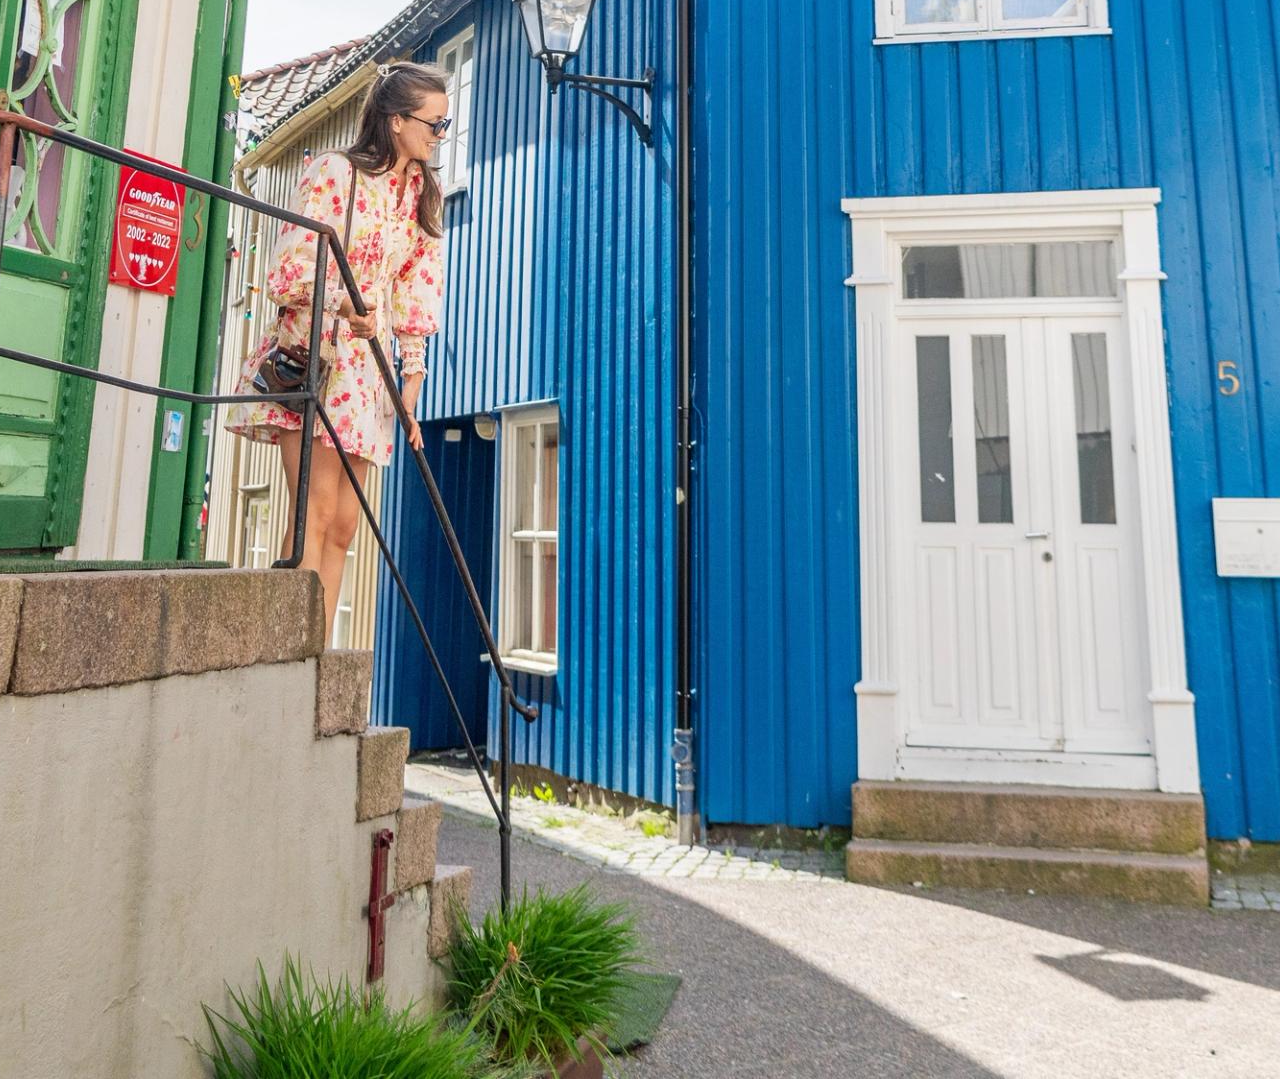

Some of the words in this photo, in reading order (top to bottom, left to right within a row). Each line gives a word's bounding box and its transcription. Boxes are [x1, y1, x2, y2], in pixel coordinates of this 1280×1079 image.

[129, 188, 175, 210] GOODYEAR
[186, 191, 204, 249] 3
[126, 224, 146, 242] 2002
[152, 231, 171, 249] 2022
[1217, 360, 1240, 396] 5
